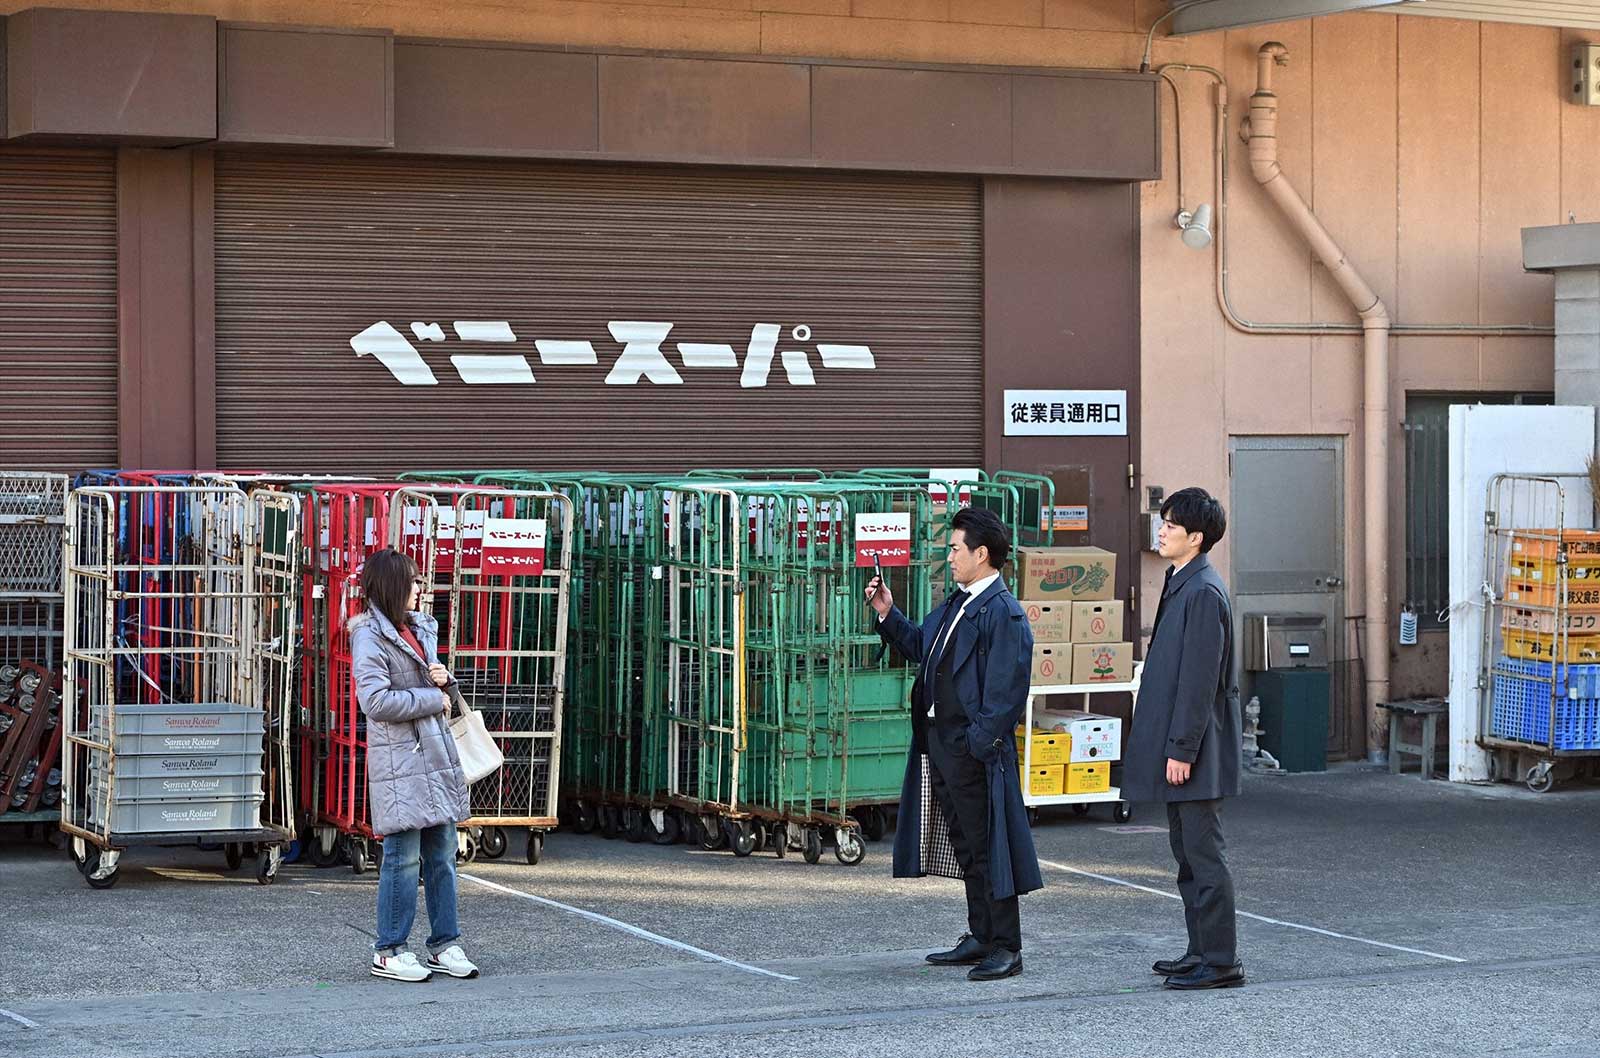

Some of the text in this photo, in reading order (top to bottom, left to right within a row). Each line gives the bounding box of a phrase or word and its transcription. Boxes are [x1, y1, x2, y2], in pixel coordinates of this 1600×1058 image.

[349, 320, 876, 388] ベニースーパー
[1011, 402, 1121, 424] 従業員通用口
[489, 531, 542, 539] ベニースーパー
[487, 555, 541, 565] ベニースーパー
[165, 717, 221, 726] Sanwa Roland
[163, 737, 191, 747] Sanwa
[191, 737, 220, 746] Roland
[161, 759, 218, 769] Sanwa Roland
[162, 779, 219, 789] Sanwa Roland
[160, 809, 218, 819] Sanwa Roland
